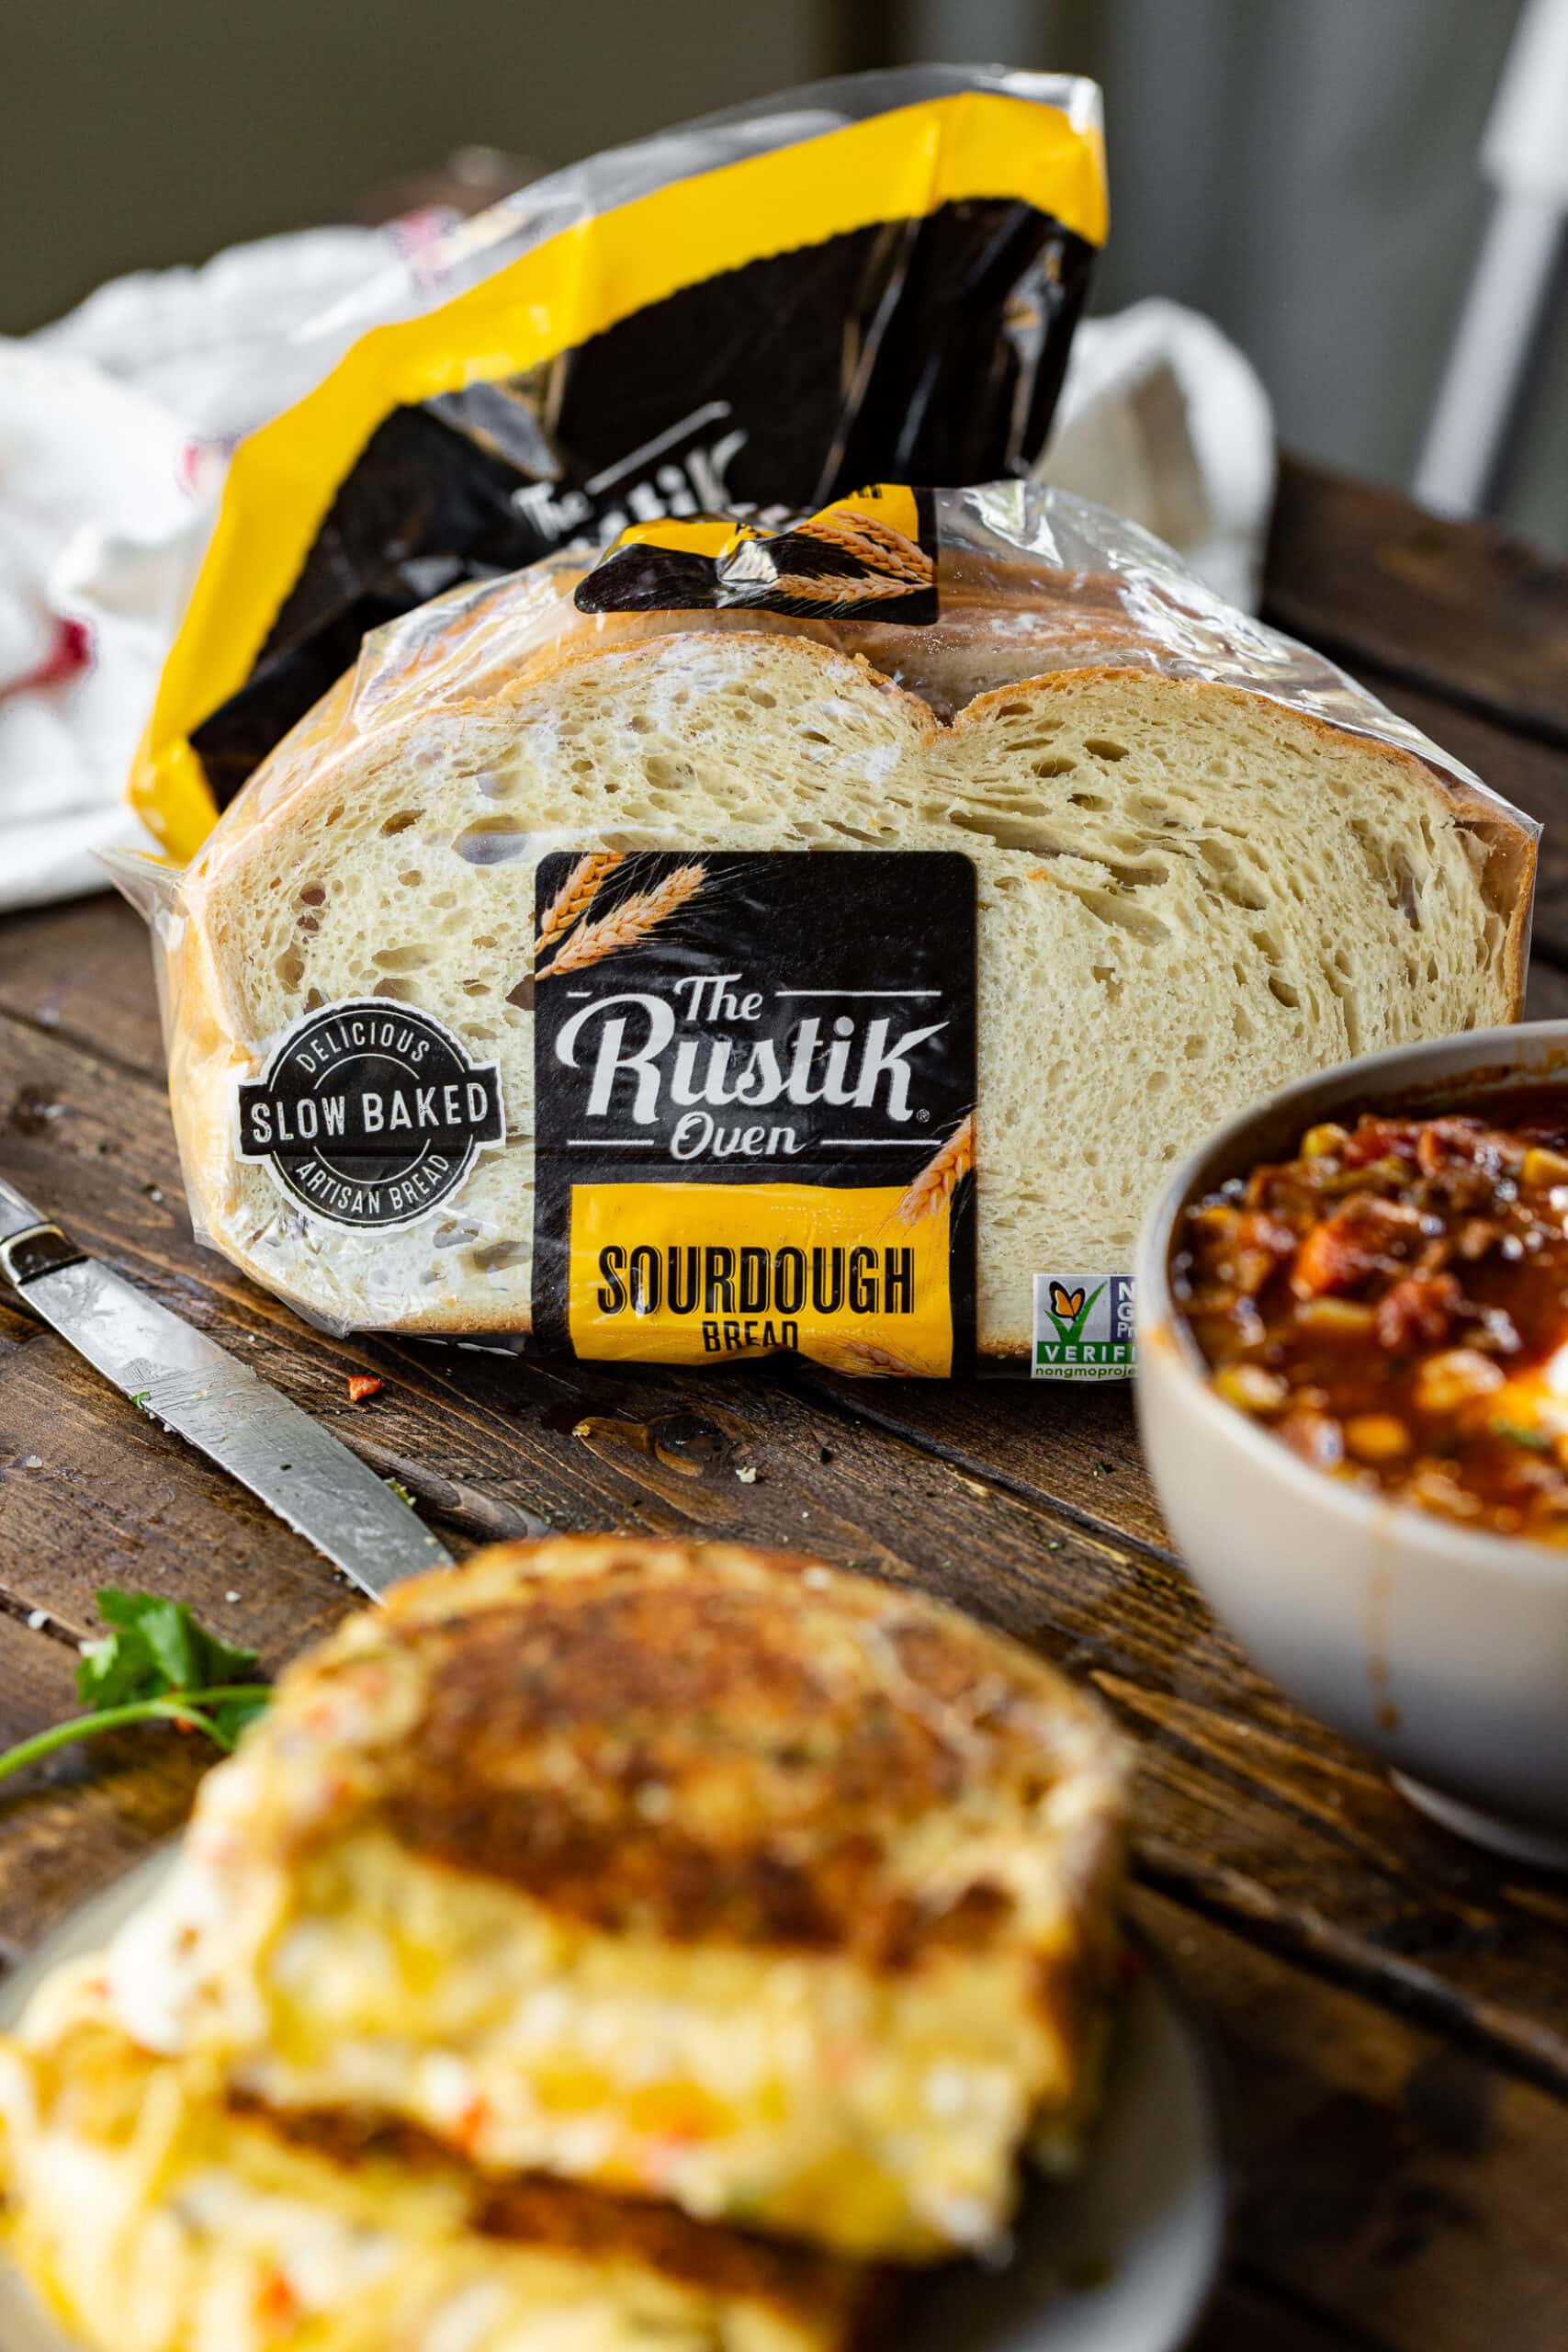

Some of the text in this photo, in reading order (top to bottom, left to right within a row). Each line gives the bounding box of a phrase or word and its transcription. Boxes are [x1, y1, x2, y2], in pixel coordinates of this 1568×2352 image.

[673, 973, 763, 1023] The
[295, 1021, 431, 1074] DELICIOUS
[251, 1081, 489, 1144] SLOW BAKED
[670, 1111, 808, 1161] Oven
[295, 1153, 450, 1215] ARTISAN BREAD
[597, 1245, 916, 1315] SOURDOUGH
[702, 1320, 798, 1352] BREAD
[1043, 1344, 1136, 1363] VERIFI
